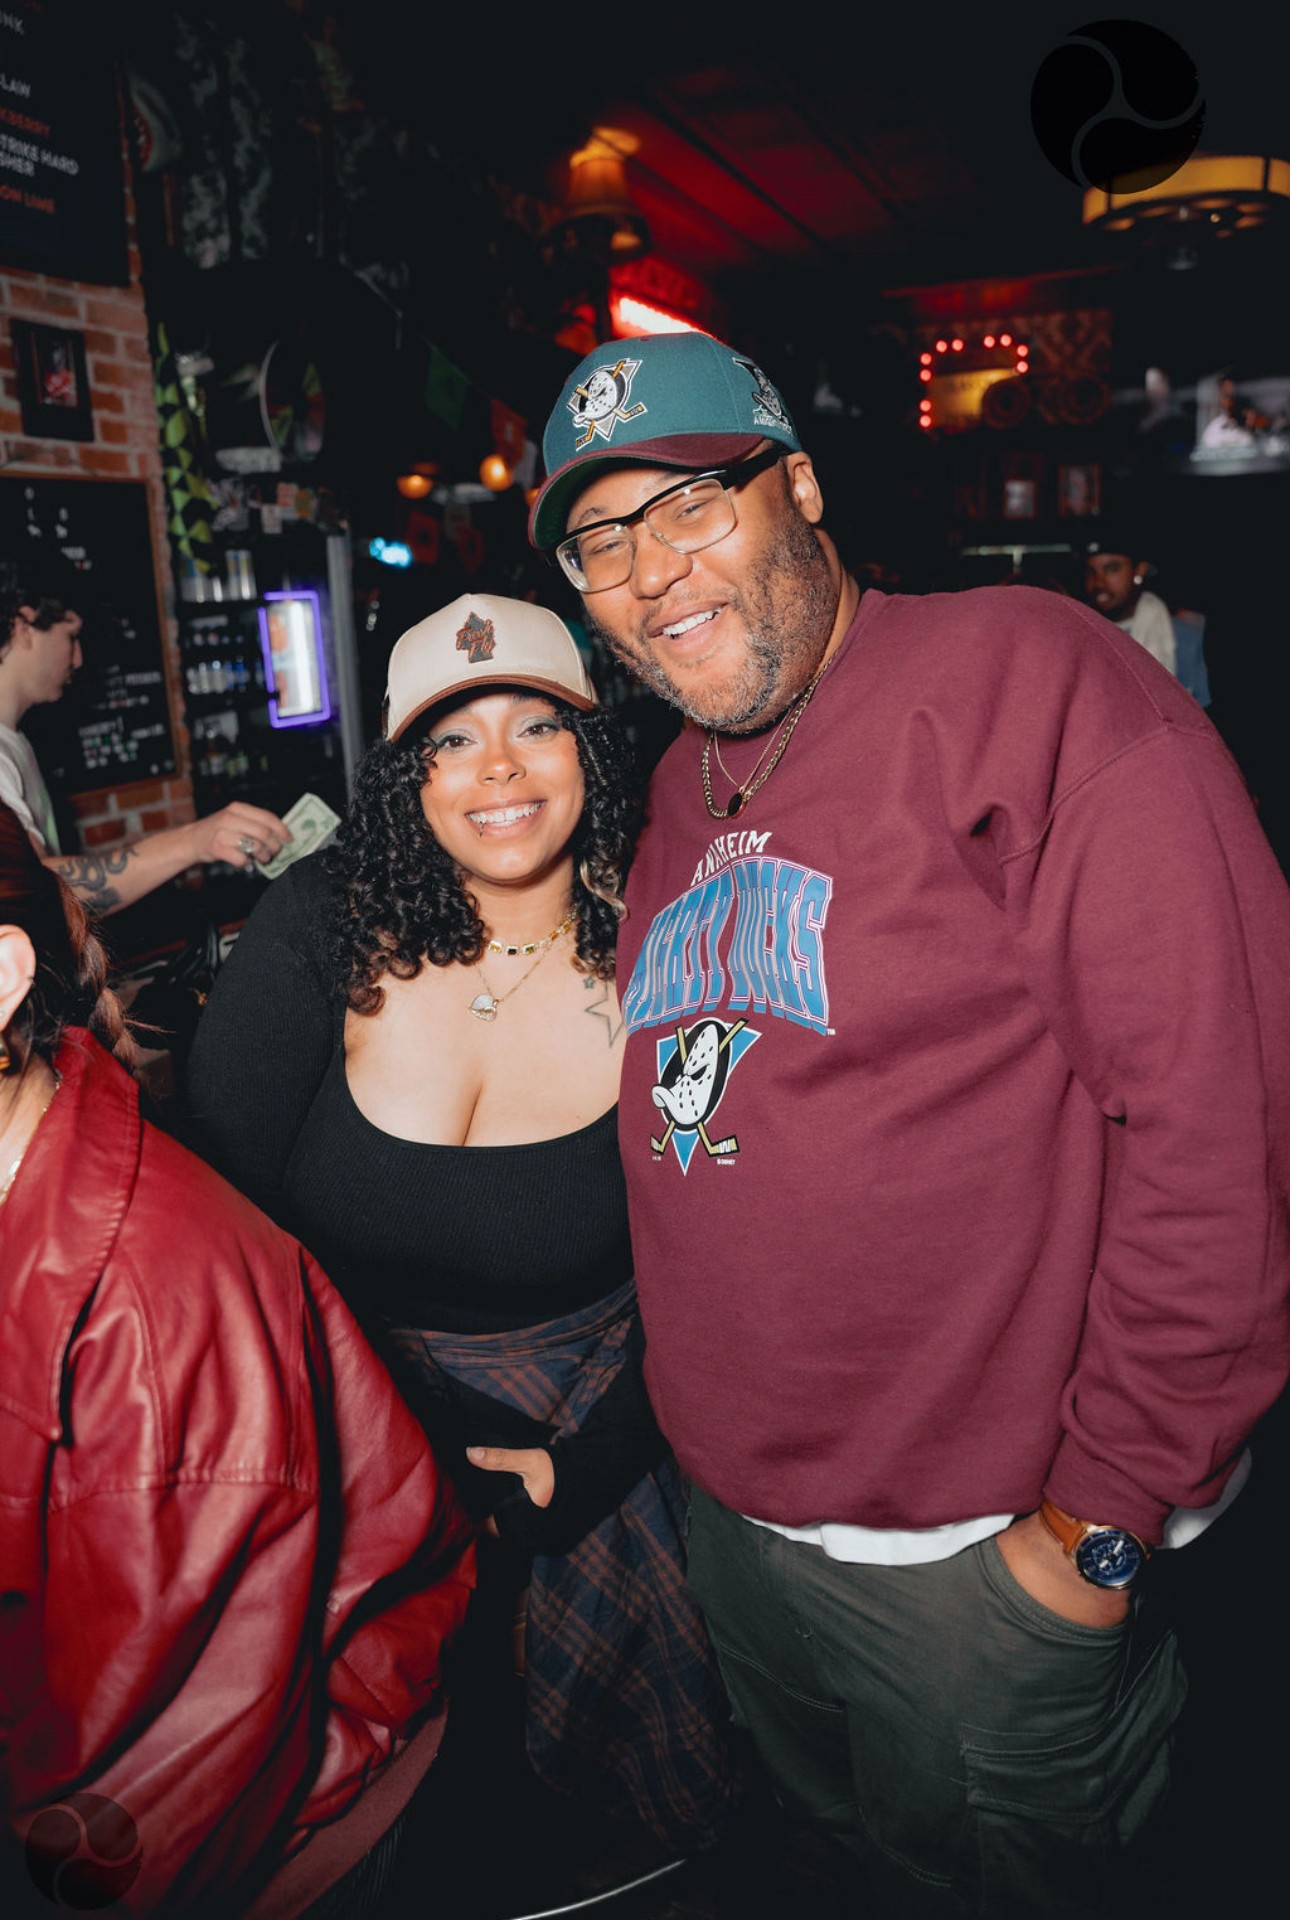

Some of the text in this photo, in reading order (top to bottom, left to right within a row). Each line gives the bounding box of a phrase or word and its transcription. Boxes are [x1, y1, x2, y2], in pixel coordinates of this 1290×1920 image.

[40, 149, 80, 176] HARD
[690, 831, 773, 887] ANAHEIM
[727, 857, 833, 1036] DUCKS
